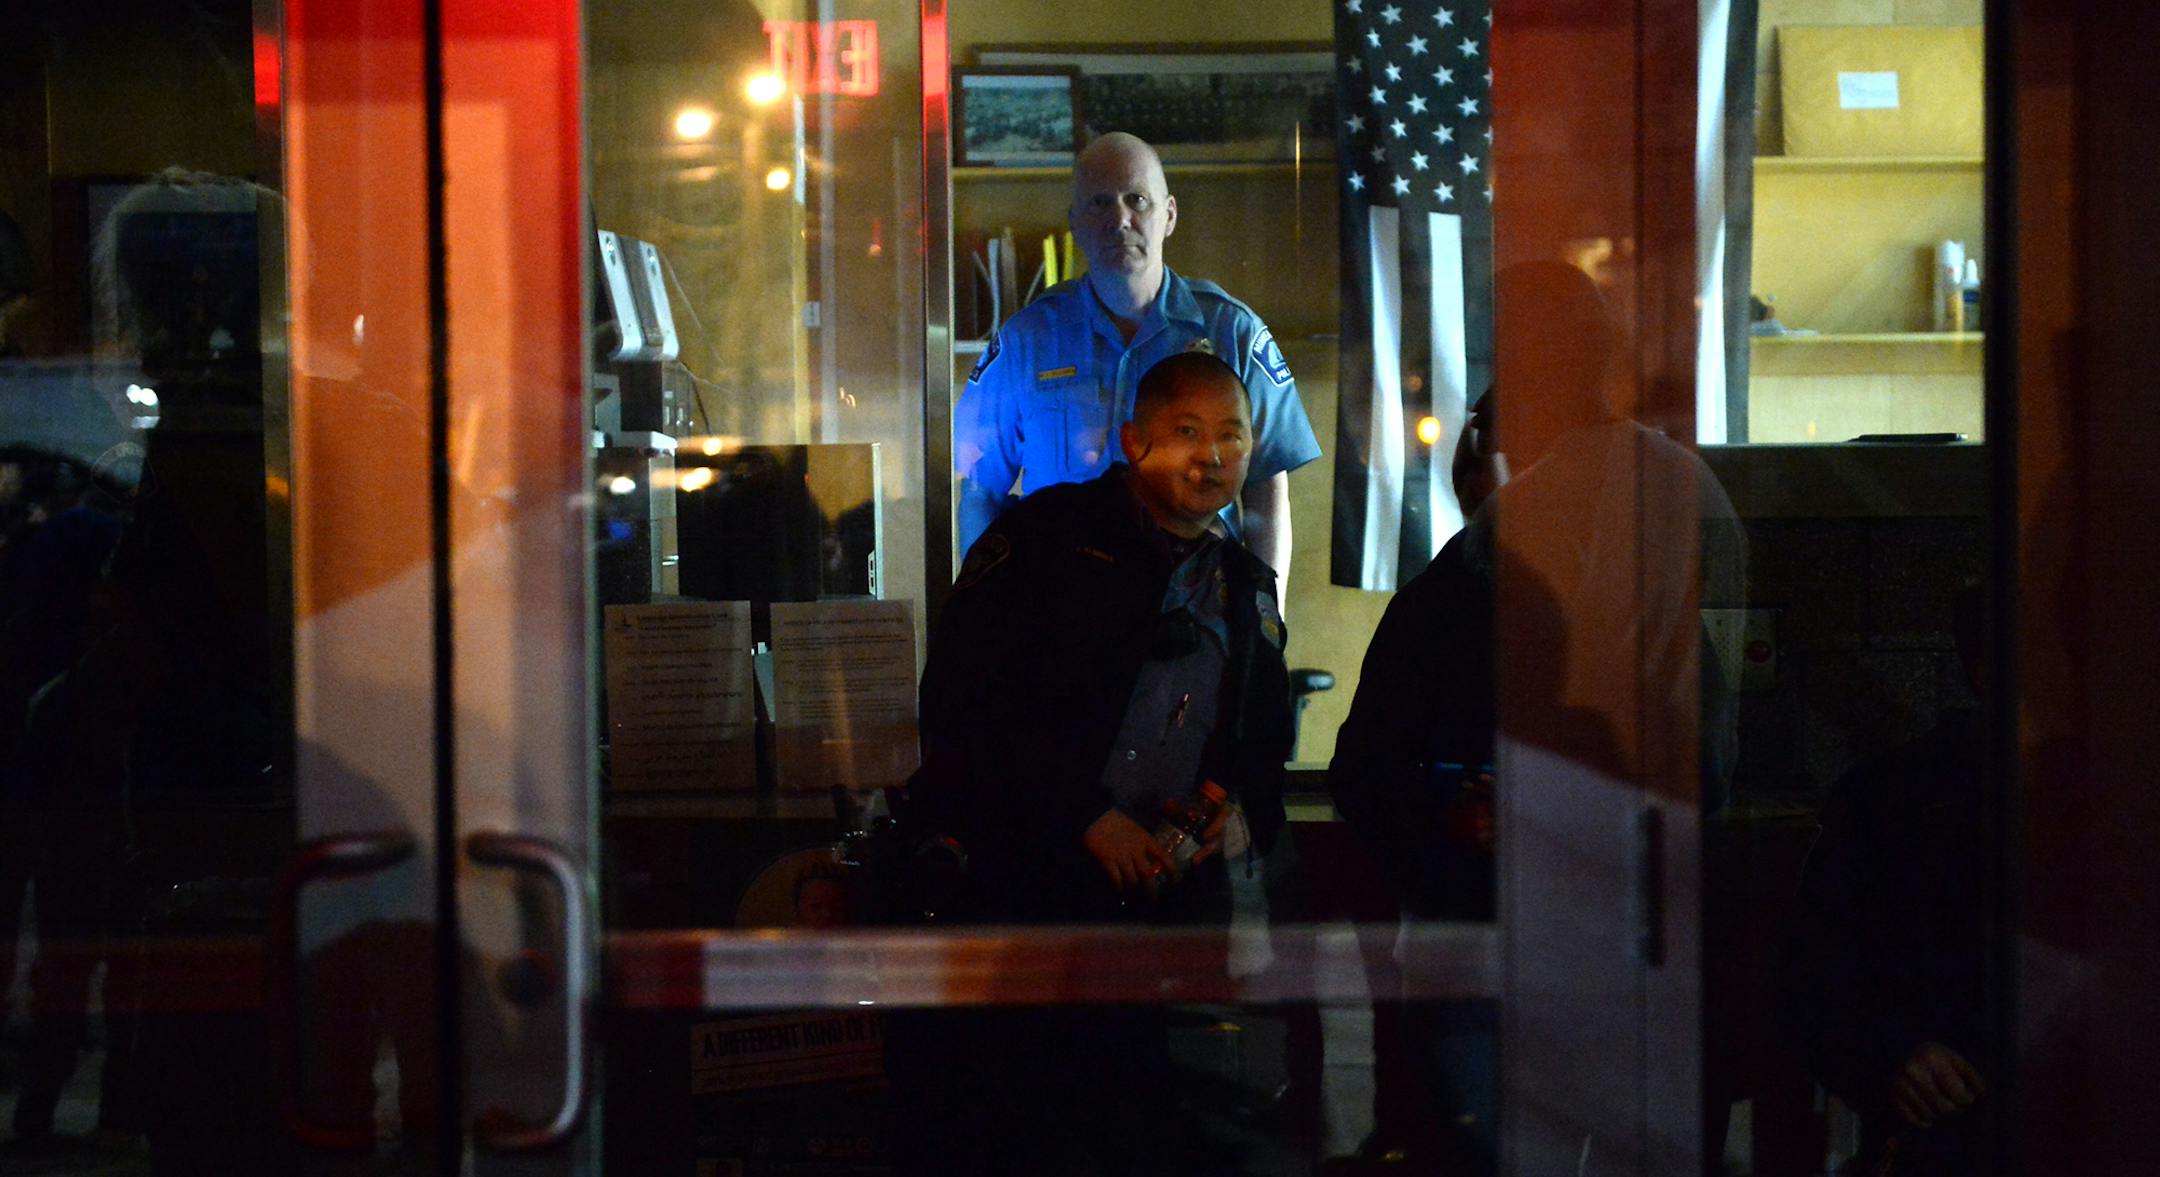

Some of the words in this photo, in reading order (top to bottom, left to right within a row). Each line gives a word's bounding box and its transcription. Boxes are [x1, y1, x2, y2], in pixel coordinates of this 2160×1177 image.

[703, 1034, 716, 1058] A
[720, 1024, 800, 1055] DIFFERENT
[804, 1020, 843, 1047] KIND
[847, 1015, 864, 1040] OF
